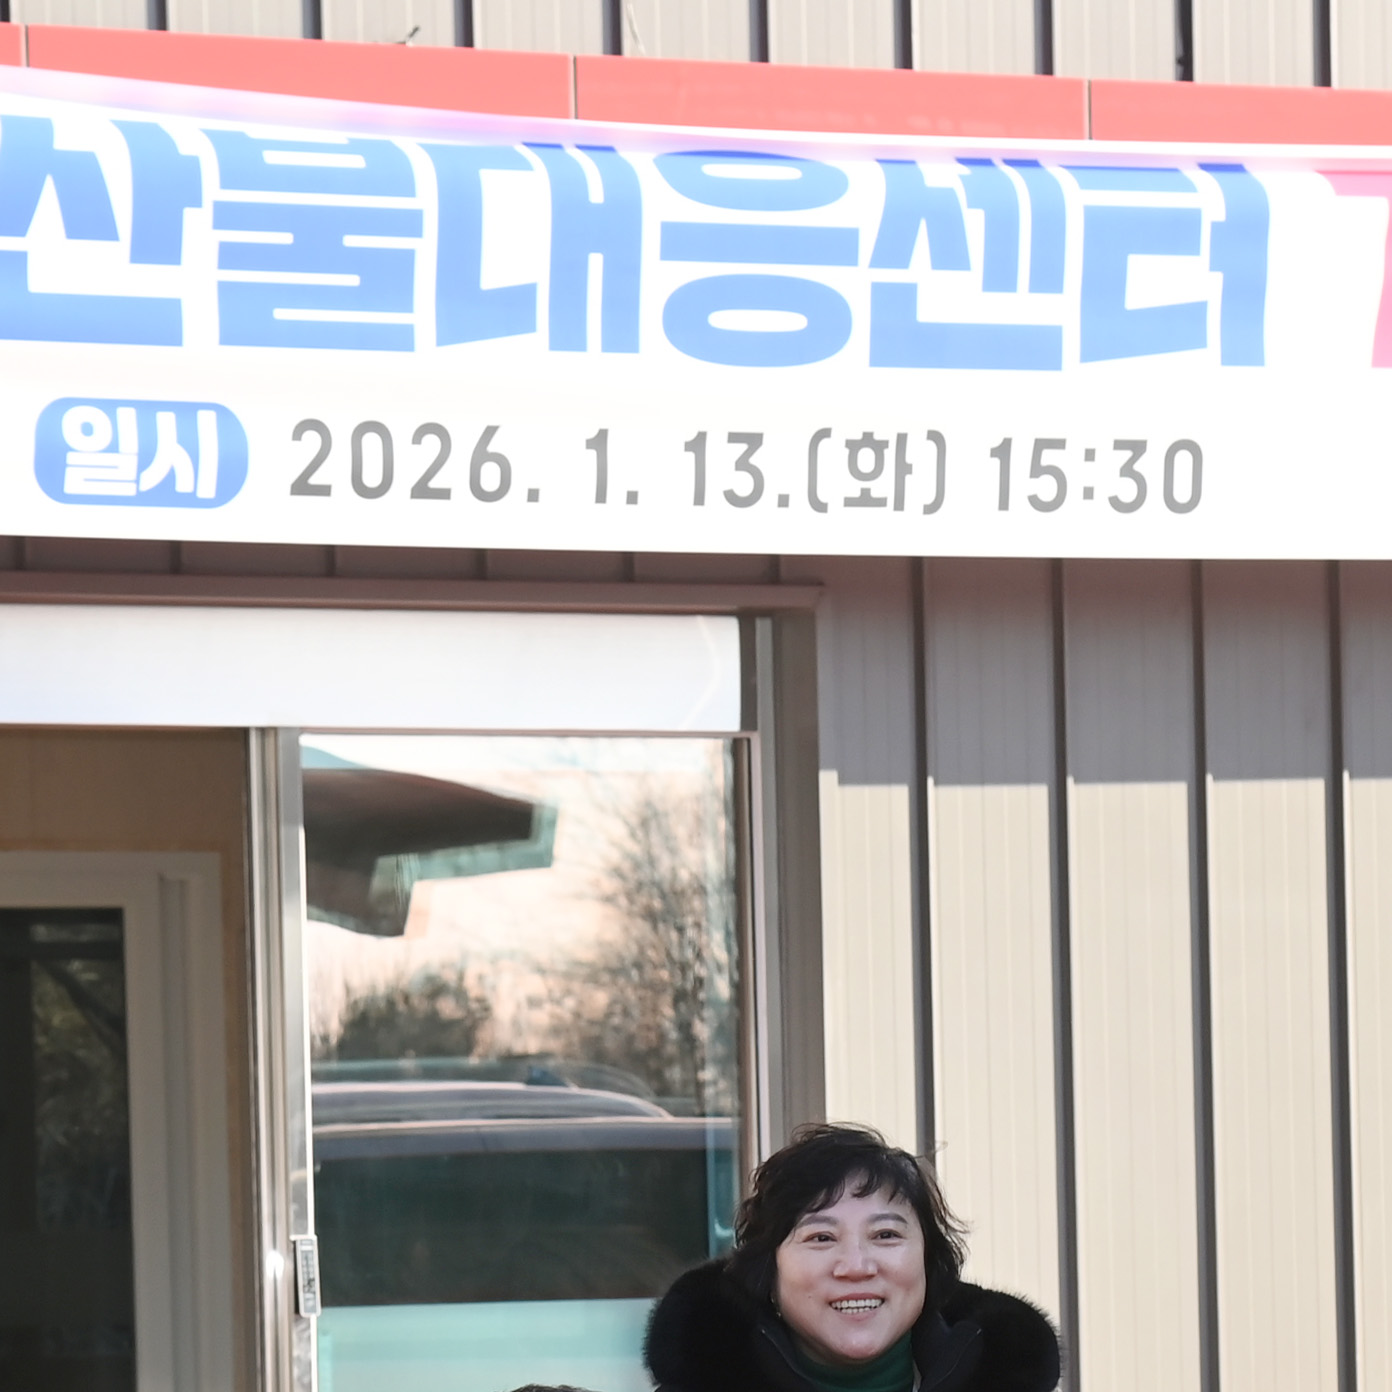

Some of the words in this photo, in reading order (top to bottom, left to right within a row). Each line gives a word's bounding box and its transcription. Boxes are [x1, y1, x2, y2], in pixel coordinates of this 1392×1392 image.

[60, 405, 218, 499] 일시
[289, 418, 540, 503] 2026.
[585, 428, 638, 506] 1.
[683, 427, 947, 515] 13.(화)
[989, 437, 1204, 515] 15:30
